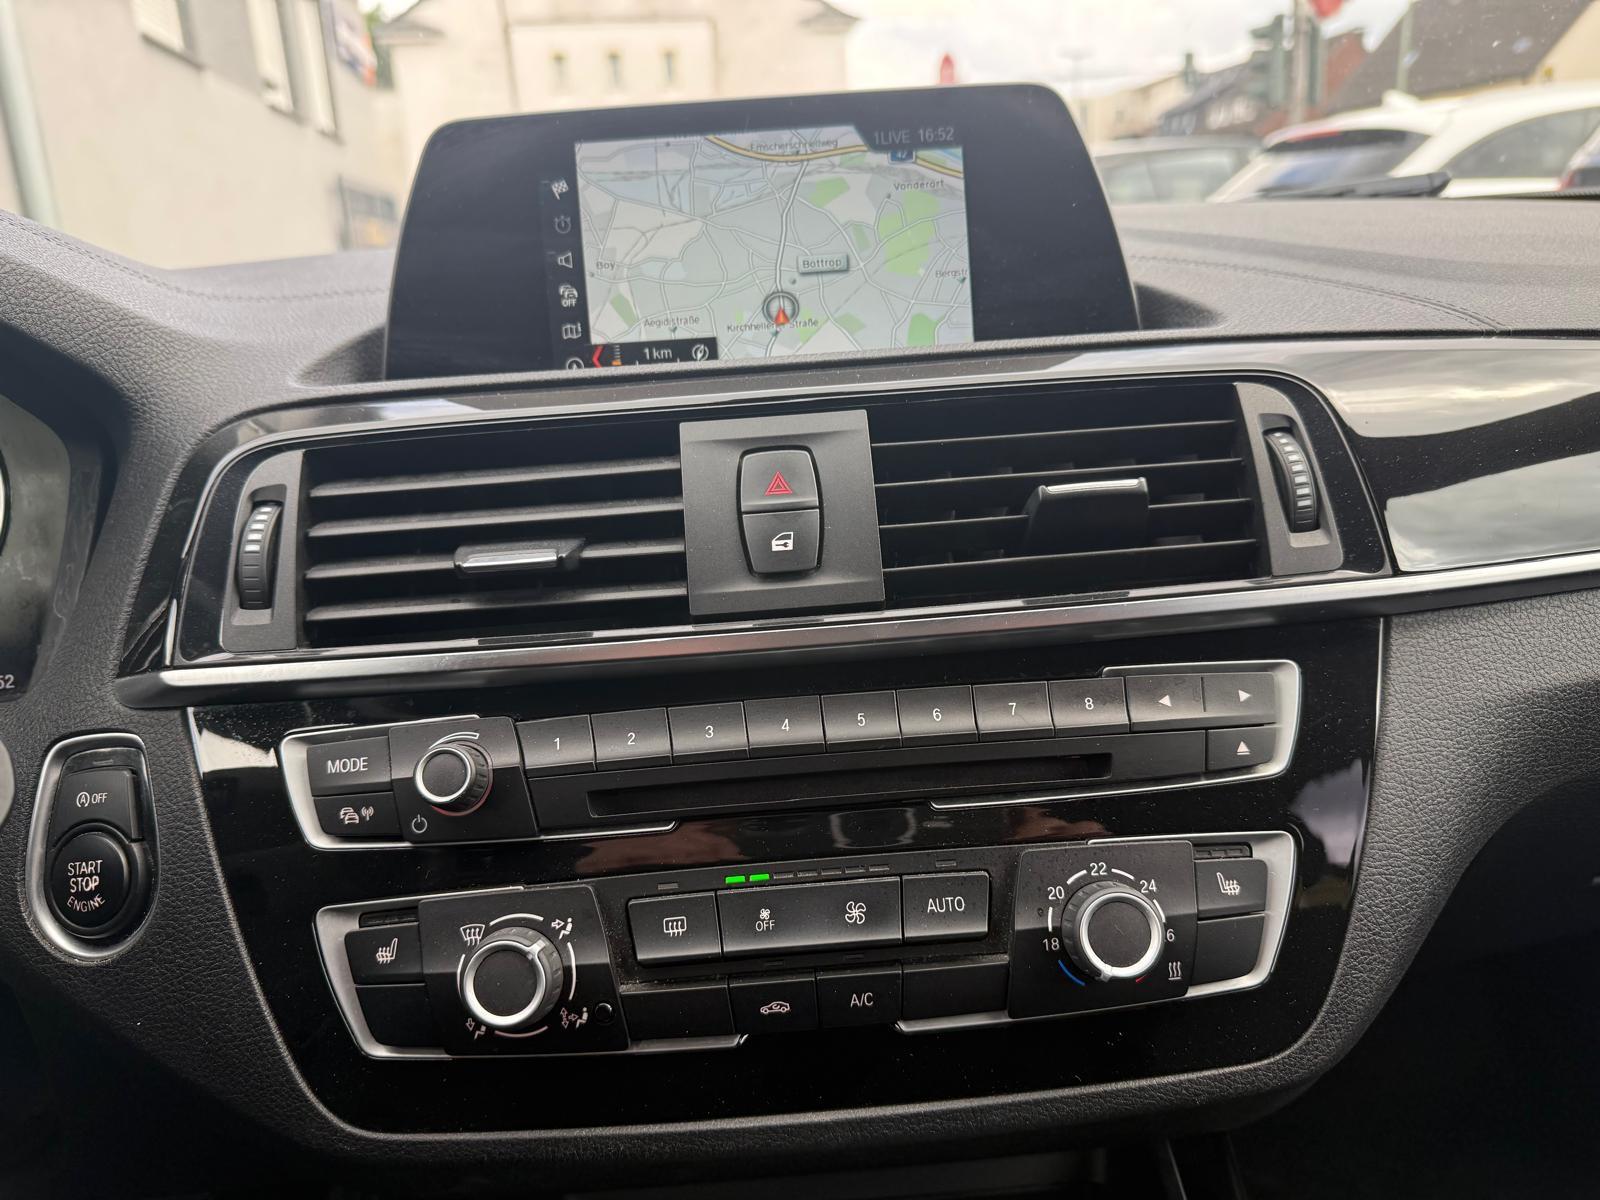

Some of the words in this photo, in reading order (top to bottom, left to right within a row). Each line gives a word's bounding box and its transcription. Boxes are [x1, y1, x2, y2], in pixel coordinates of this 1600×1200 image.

[873, 128, 911, 145] 1LIVE
[918, 127, 955, 143] 16:52
[893, 179, 945, 191] Vonderort
[596, 260, 616, 271] Boy
[802, 258, 842, 271] Bottrop
[561, 298, 577, 308] OFF
[789, 318, 819, 330] Straße
[644, 349, 651, 360] 1
[652, 347, 673, 360] km
[1008, 702, 1017, 716] 7
[1084, 697, 1094, 710] 8
[857, 712, 866, 727] 5
[932, 708, 942, 722] 6
[705, 726, 714, 739] 3
[781, 719, 790, 732] 4
[553, 737, 561, 750] 1
[627, 732, 636, 746] 2
[327, 756, 369, 774] MODE
[92, 792, 108, 804] OFF
[67, 859, 103, 876] START
[1089, 861, 1108, 876] 22
[70, 875, 100, 893] STOP
[1139, 878, 1158, 893] 24
[1047, 886, 1066, 900] 20
[66, 893, 106, 913] ENGINE
[927, 896, 966, 914] AUTO
[755, 919, 776, 932] OFF
[1165, 928, 1176, 943] 6
[1042, 937, 1060, 952] 18
[850, 992, 874, 1008] A/C
